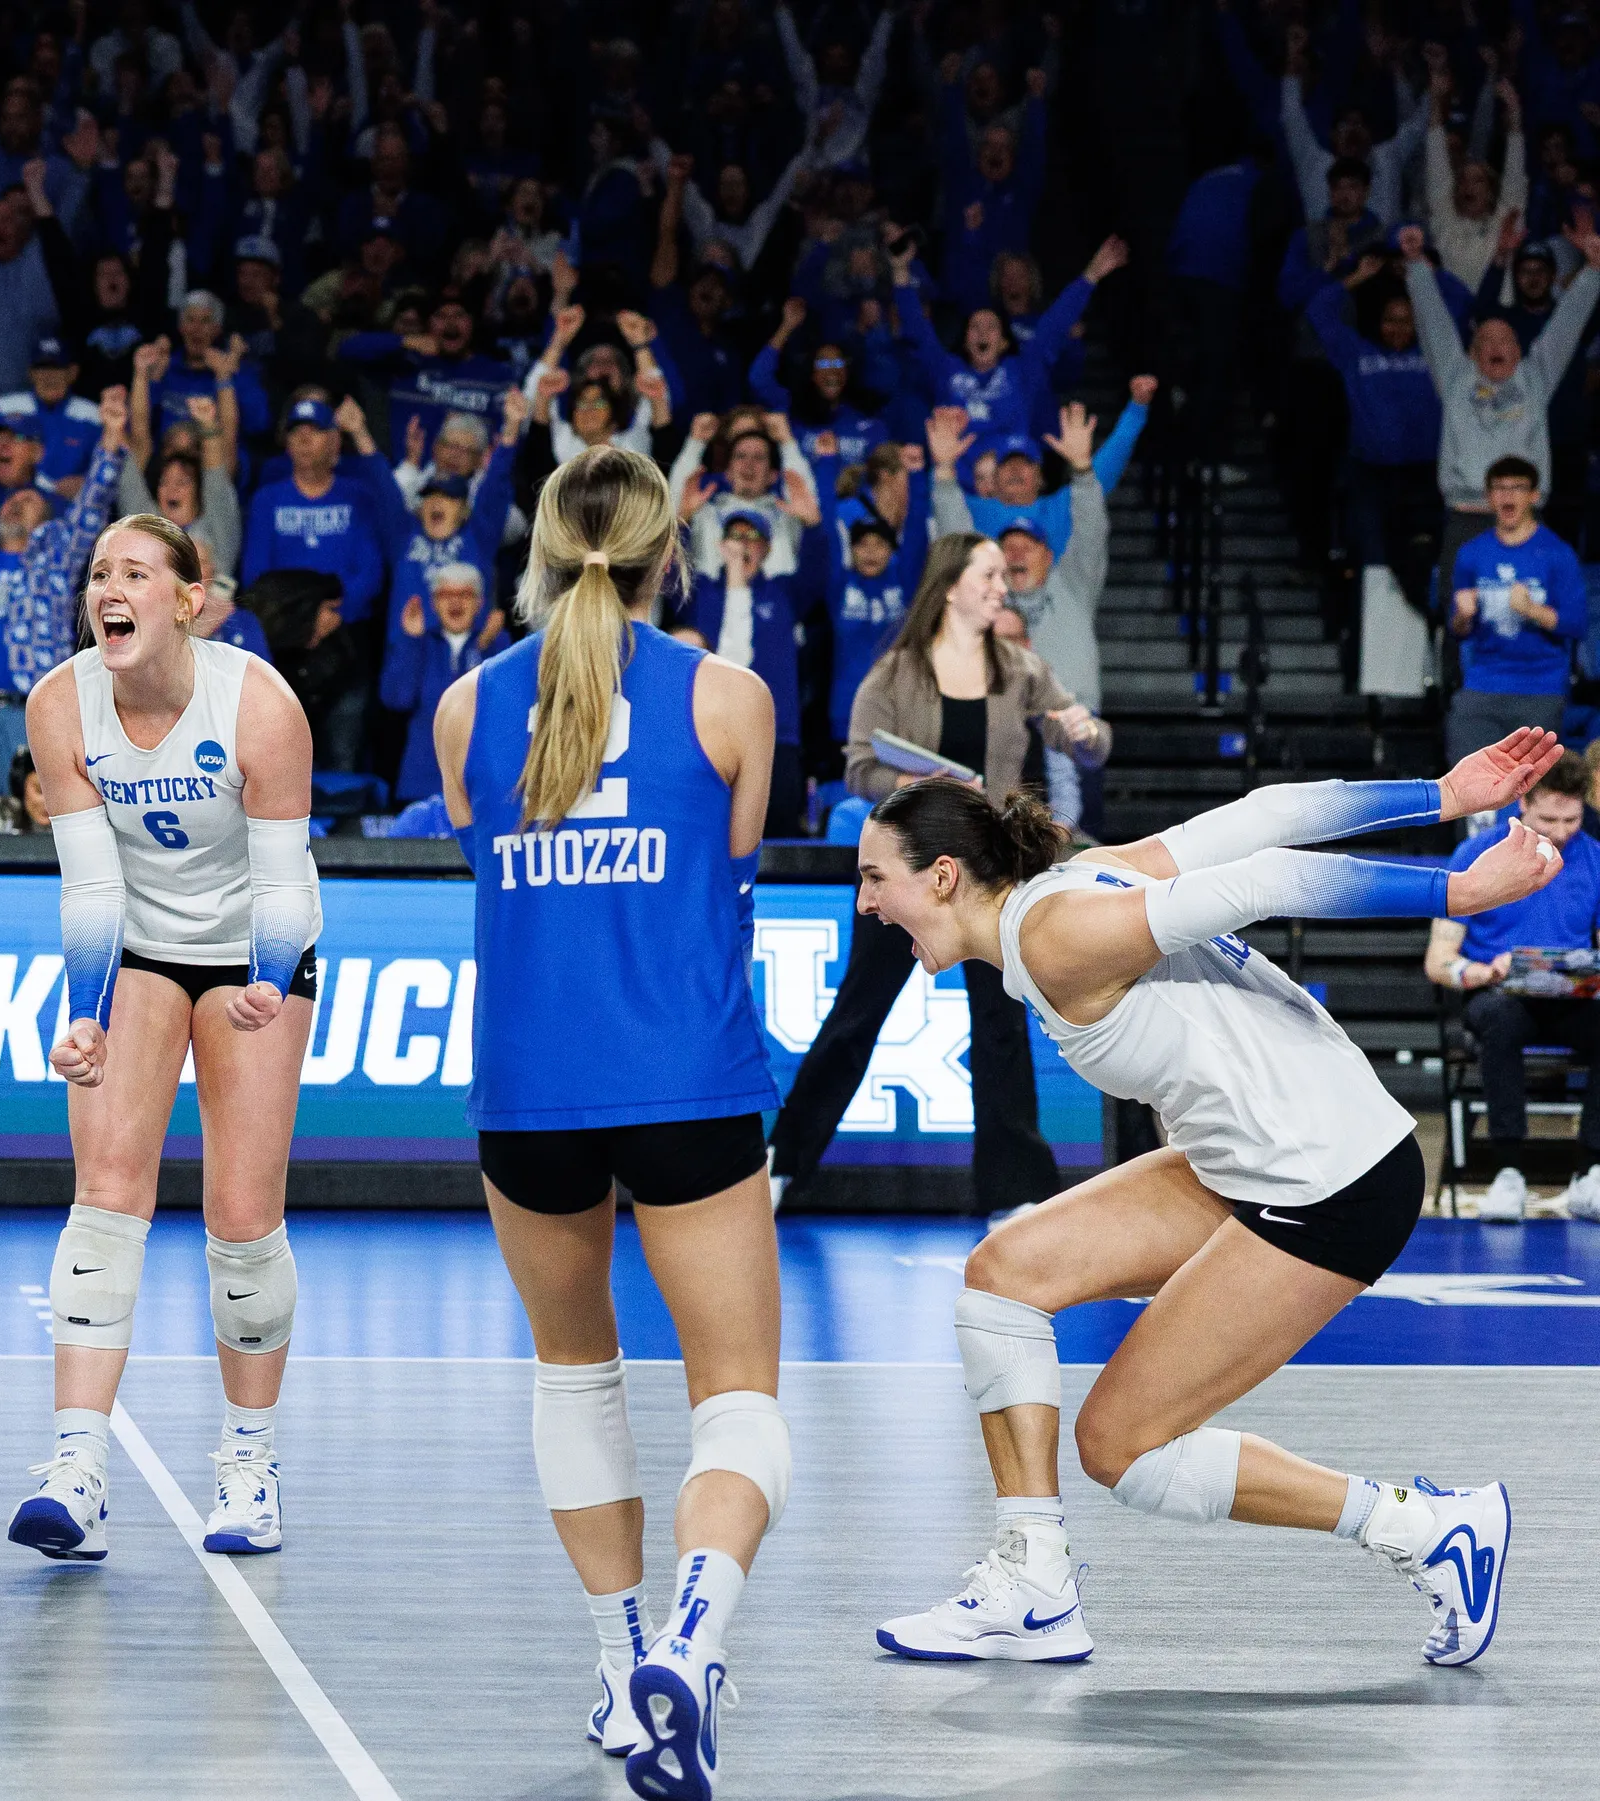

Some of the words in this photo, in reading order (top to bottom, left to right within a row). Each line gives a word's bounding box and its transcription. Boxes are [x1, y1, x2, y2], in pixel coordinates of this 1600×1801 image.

[199, 754, 226, 767] NCAA
[99, 776, 217, 805] KENTUCKY
[142, 811, 190, 849] 6
[493, 827, 667, 890] TUOZZO
[59, 1450, 78, 1459] NIKE
[235, 1449, 254, 1457] NIKE
[1041, 1613, 1075, 1635] KENTUCKY
